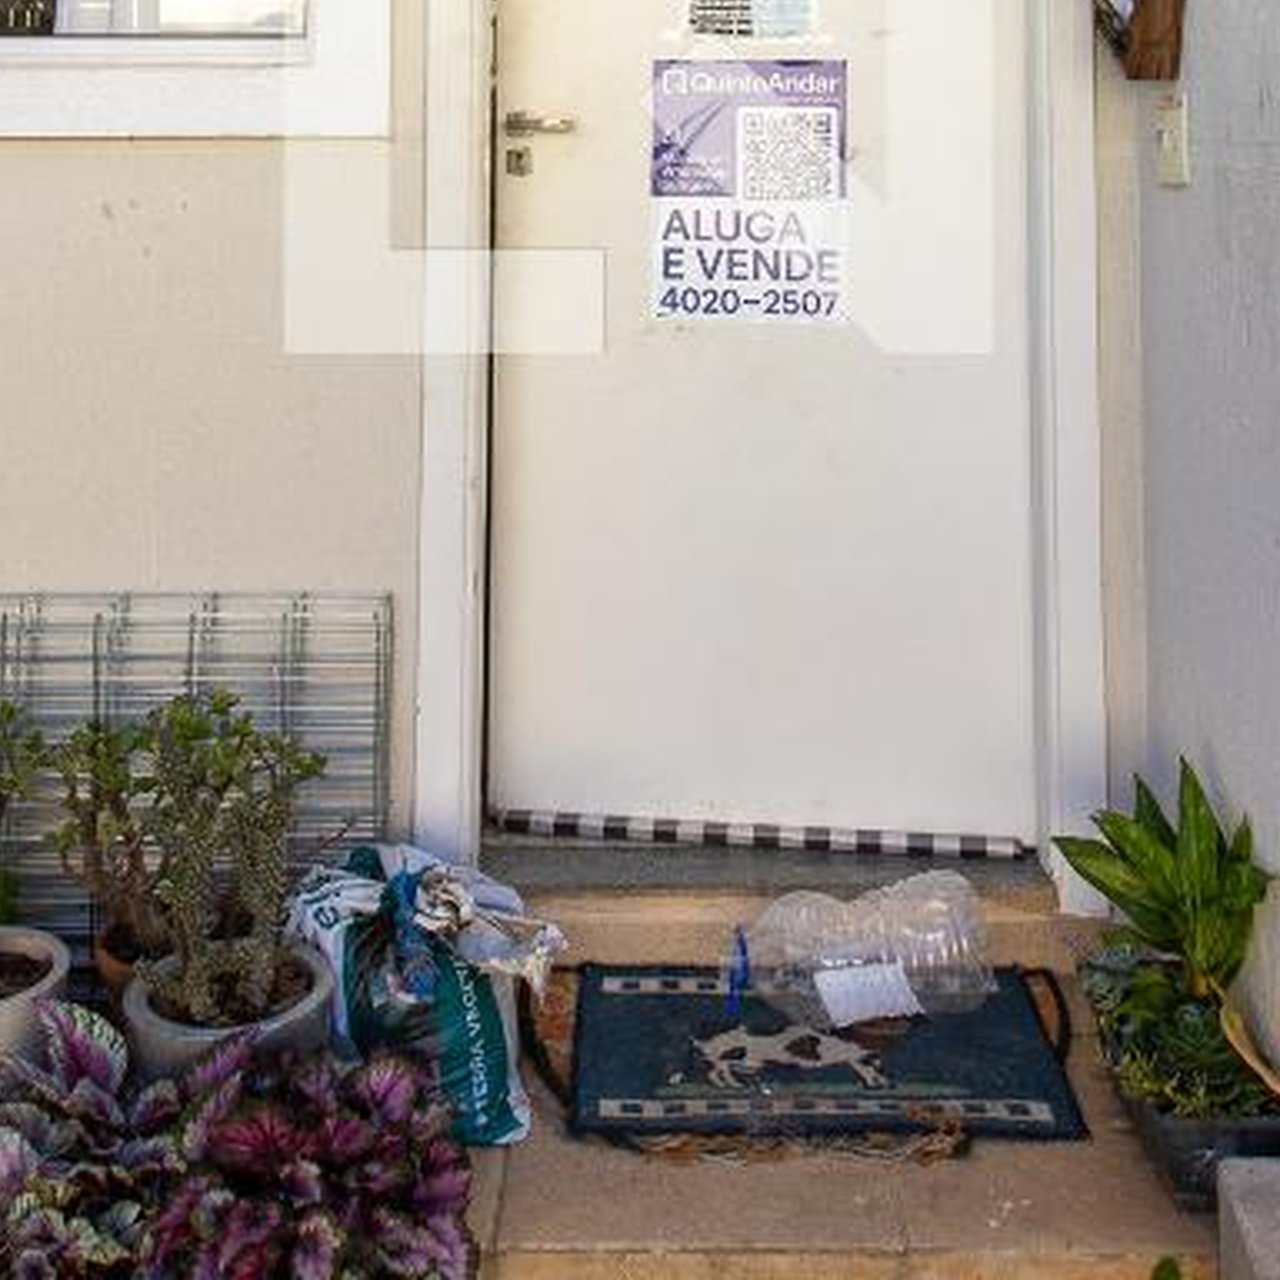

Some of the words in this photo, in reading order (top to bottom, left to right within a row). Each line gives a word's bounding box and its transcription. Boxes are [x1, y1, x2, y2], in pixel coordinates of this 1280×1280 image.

[690, 71, 839, 96] QuintoAndar
[662, 209, 805, 243] ALUGA
[662, 248, 684, 280] E
[696, 248, 839, 283] VENDE
[659, 287, 839, 315] 4020-2507
